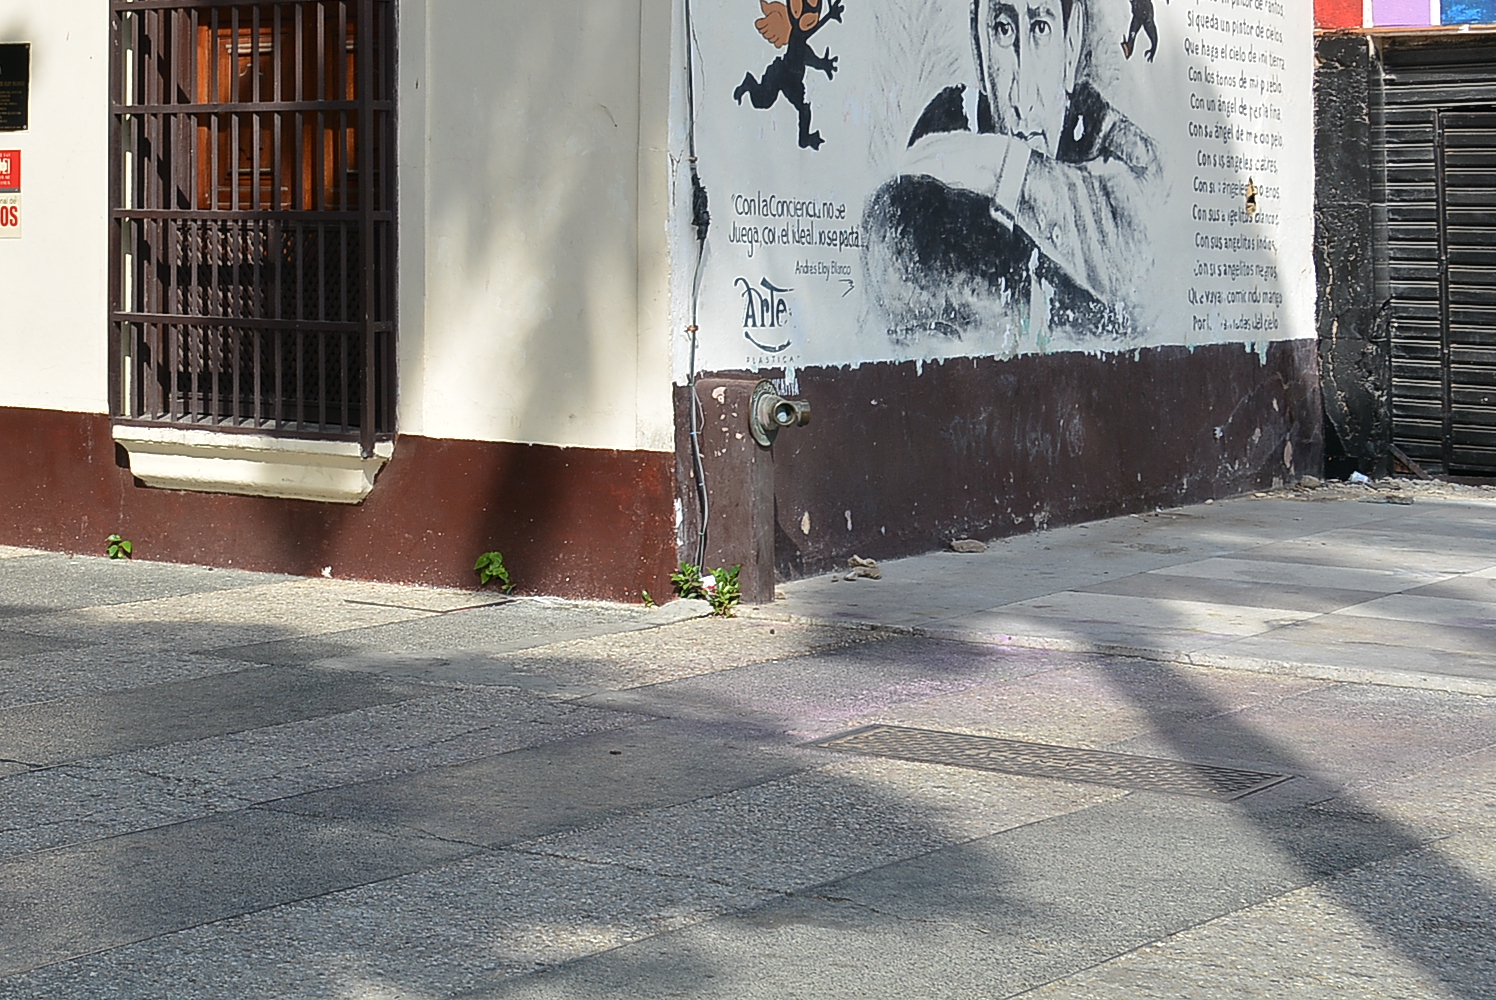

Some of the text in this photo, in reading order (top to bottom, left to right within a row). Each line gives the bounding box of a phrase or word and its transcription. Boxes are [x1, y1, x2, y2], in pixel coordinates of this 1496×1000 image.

[1187, 10, 1194, 28] Si
[1195, 13, 1219, 33] queda
[1220, 19, 1230, 33] un
[1232, 18, 1254, 37] pintor
[1255, 20, 1264, 39] de
[1184, 37, 1200, 56] Que
[1201, 38, 1219, 62] haga
[1220, 43, 1228, 60] el
[1229, 45, 1247, 62] cielo
[1248, 43, 1257, 63] de
[1188, 65, 1203, 82] Con
[1204, 65, 1215, 85] los
[1215, 70, 1236, 88] tonos
[1238, 69, 1247, 89] de
[1190, 92, 1205, 110] Con
[1238, 97, 1248, 116] de
[1188, 121, 1204, 137] Con
[1235, 124, 1244, 141] de
[1197, 149, 1212, 167] Con
[1193, 176, 1208, 193] Con
[757, 190, 769, 217] la
[1192, 203, 1207, 221] Con
[1208, 208, 1220, 222] sus
[781, 221, 790, 245] el
[826, 229, 838, 247] se
[1195, 232, 1209, 249] Con
[1210, 236, 1223, 250] sus
